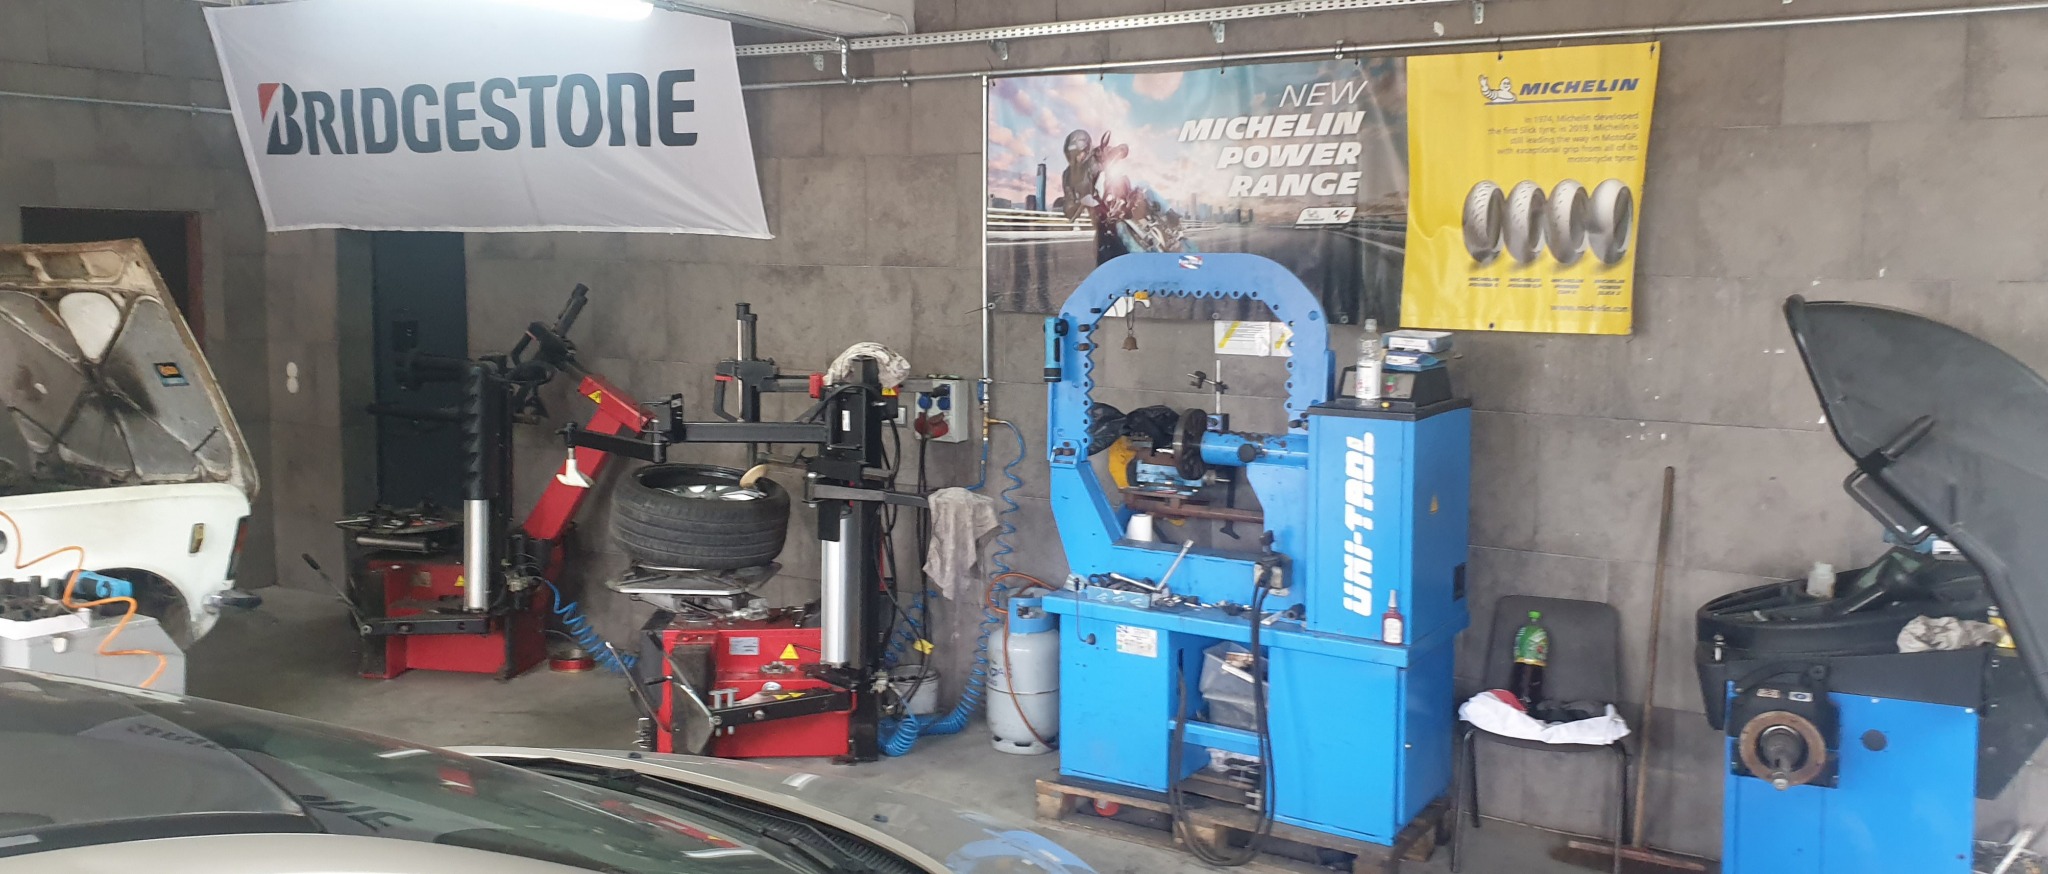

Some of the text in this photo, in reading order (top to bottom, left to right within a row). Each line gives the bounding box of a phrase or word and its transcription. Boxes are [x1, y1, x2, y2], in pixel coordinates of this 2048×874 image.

[1279, 80, 1368, 108] NEW
[1519, 78, 1640, 96] MICHELIN
[258, 69, 698, 155] BRIDGESTONE
[1178, 111, 1366, 142] MICHELIN
[1216, 142, 1362, 169] POWER
[1228, 171, 1362, 197] RANGE
[1343, 432, 1375, 617] UNI-TROL
